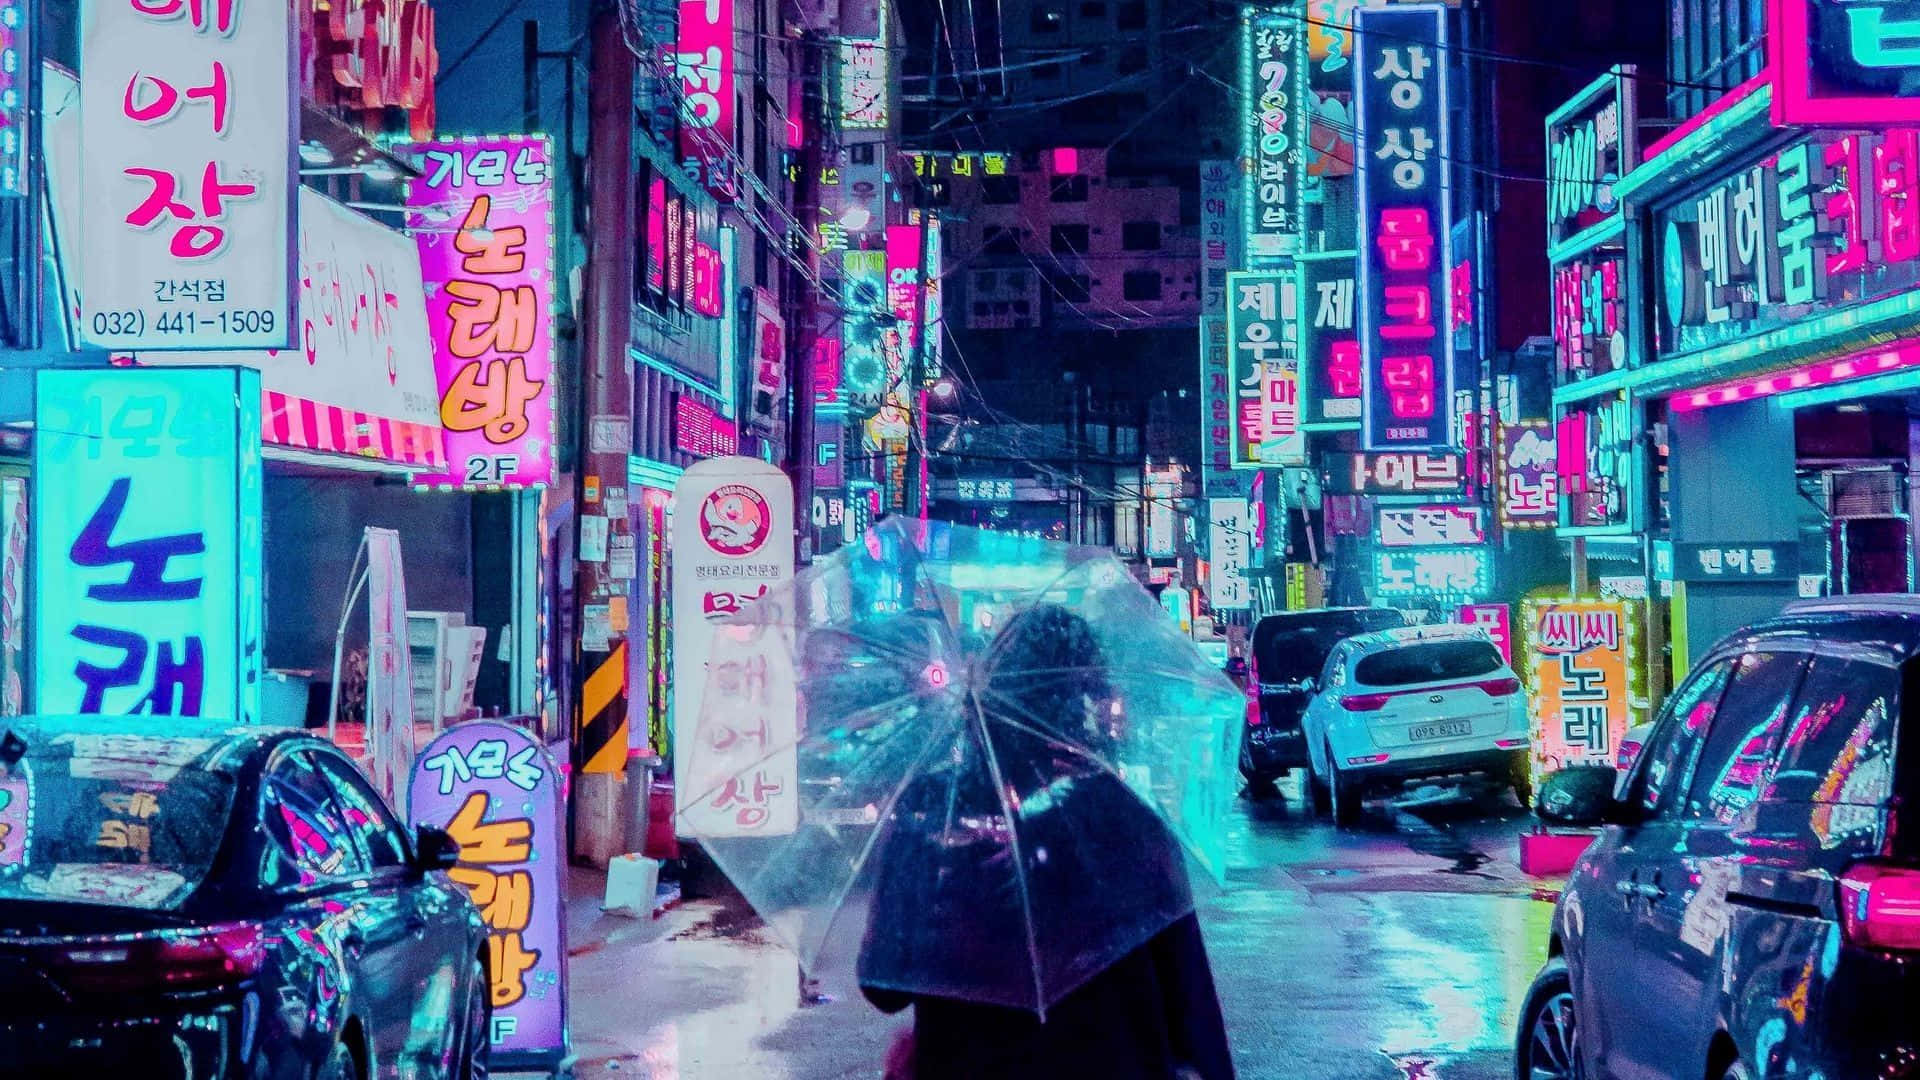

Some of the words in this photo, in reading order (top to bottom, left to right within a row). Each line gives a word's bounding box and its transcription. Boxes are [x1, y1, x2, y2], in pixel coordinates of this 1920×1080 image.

[426, 147, 547, 188] 기모노
[153, 279, 227, 303] 간석점
[891, 267, 918, 285] OK
[93, 311, 147, 337] 032)
[156, 311, 275, 334] 441-1509
[439, 195, 546, 443] 노래방
[1270, 379, 1297, 435] 마트
[467, 455, 520, 484] 2F
[1543, 611, 1619, 651] 씨씨
[424, 738, 545, 794] 기모노
